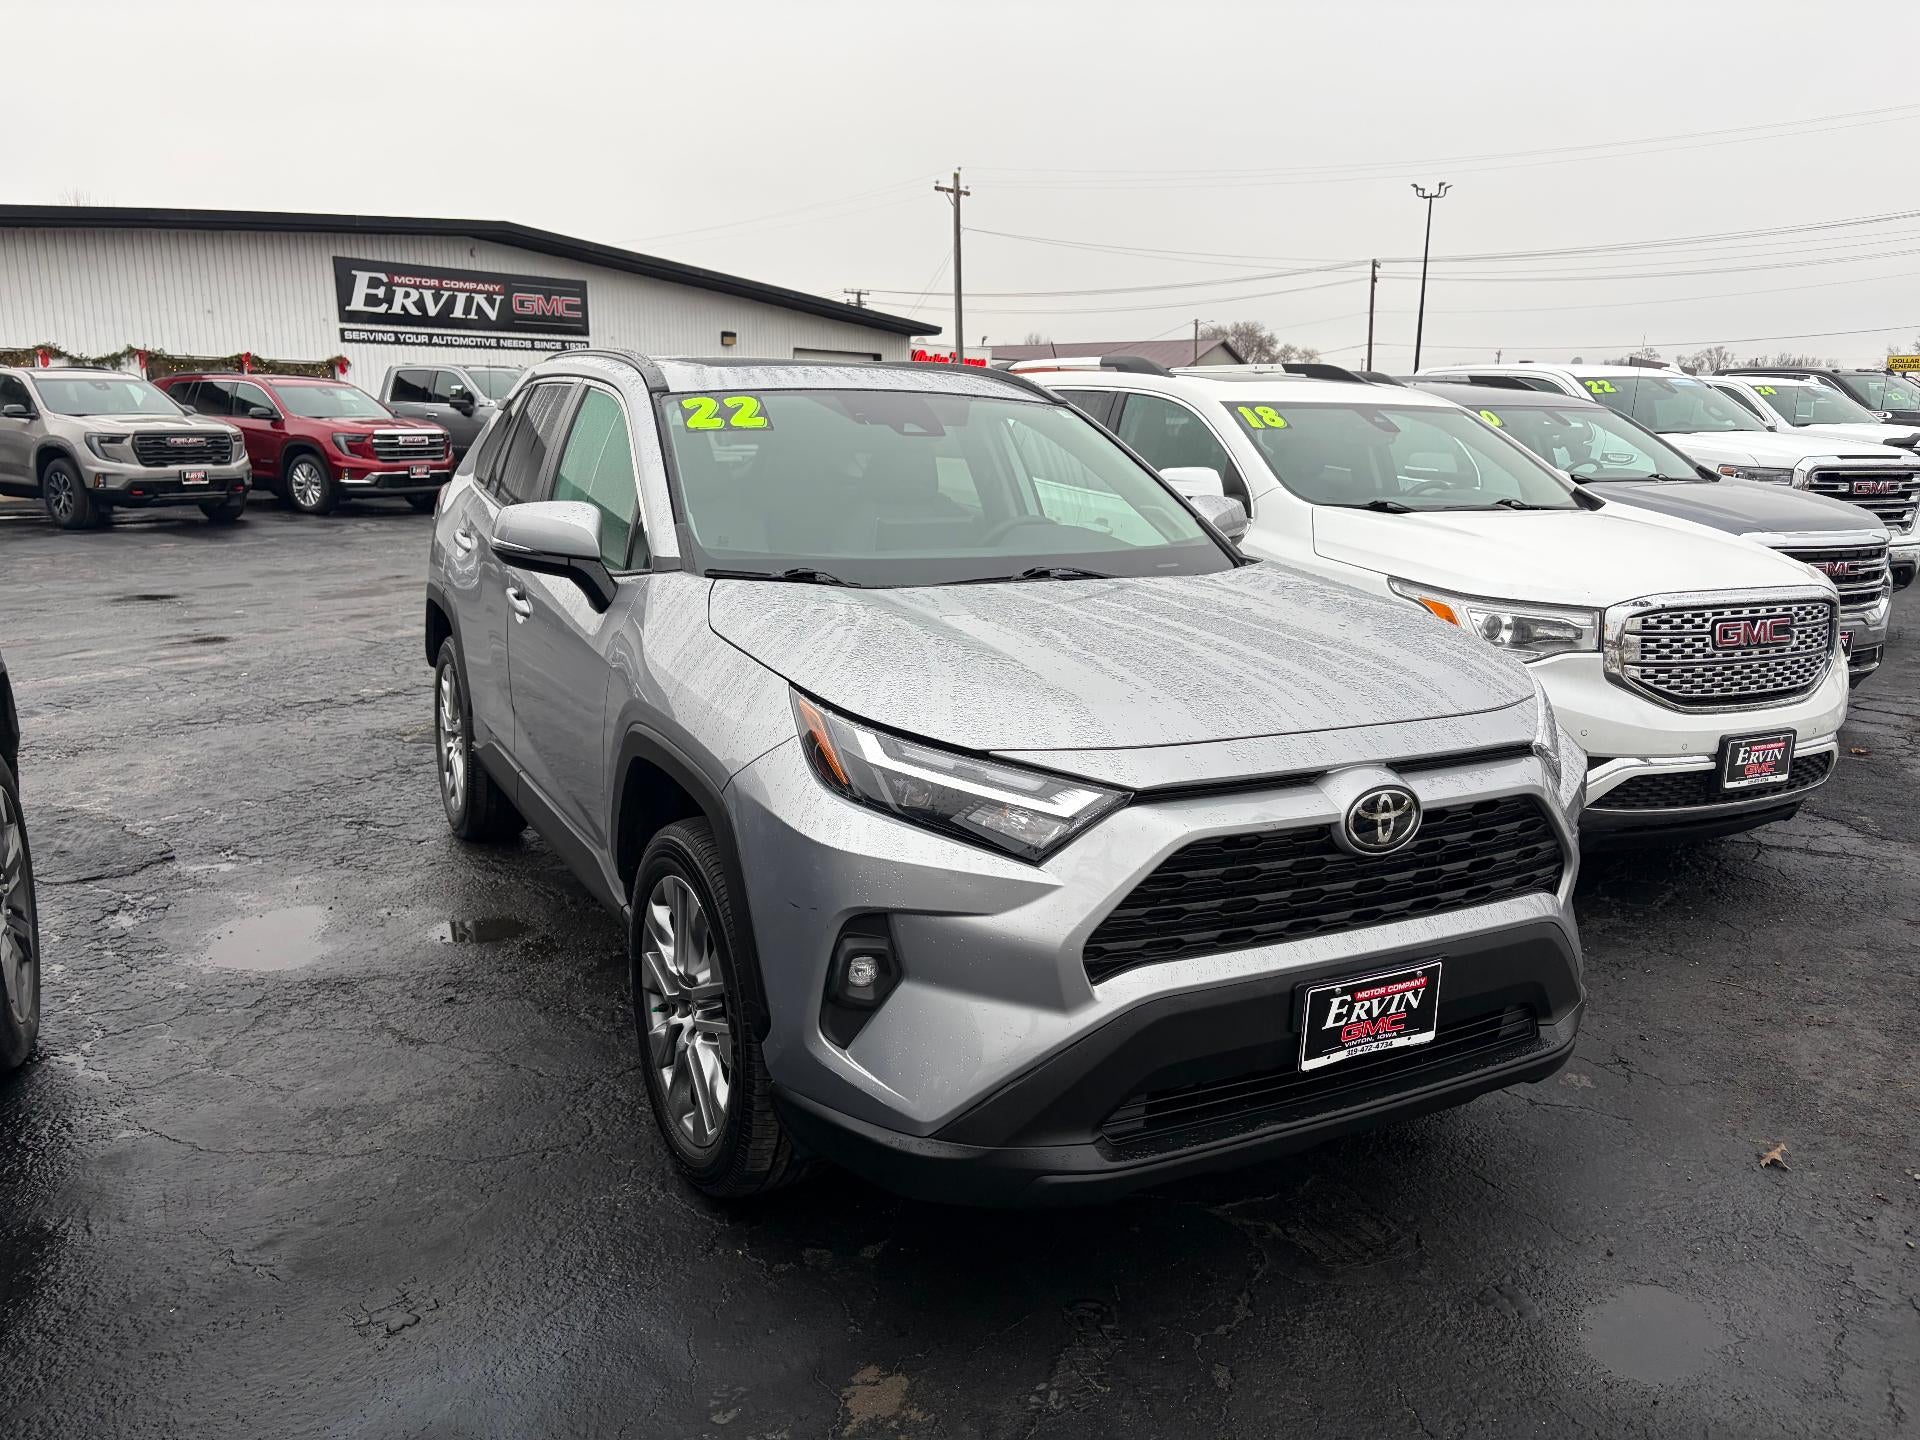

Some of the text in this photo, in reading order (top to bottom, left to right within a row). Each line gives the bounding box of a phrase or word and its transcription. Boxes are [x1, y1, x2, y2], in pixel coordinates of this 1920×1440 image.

[344, 269, 504, 321] ERVIN
[394, 274, 501, 293] MOTOR COMPANY
[512, 292, 582, 318] GMC
[344, 331, 395, 342] SERVING
[398, 333, 429, 344] YOUR
[431, 335, 497, 348] AUTOMOTIVE
[500, 339, 532, 349] NEEDS
[534, 341, 562, 349] SINCE
[1585, 379, 1616, 394] 22
[681, 395, 768, 431] 22
[1237, 405, 1288, 429] 18
[1854, 481, 1898, 495] GMC
[1715, 617, 1791, 648] GMC
[1734, 746, 1785, 766] ERVIN
[1357, 977, 1426, 999] MOTOR COMPANY
[1322, 988, 1425, 1030] ERVIN
[1341, 1013, 1406, 1042] GMC
[1376, 1031, 1398, 1040] IOWA
